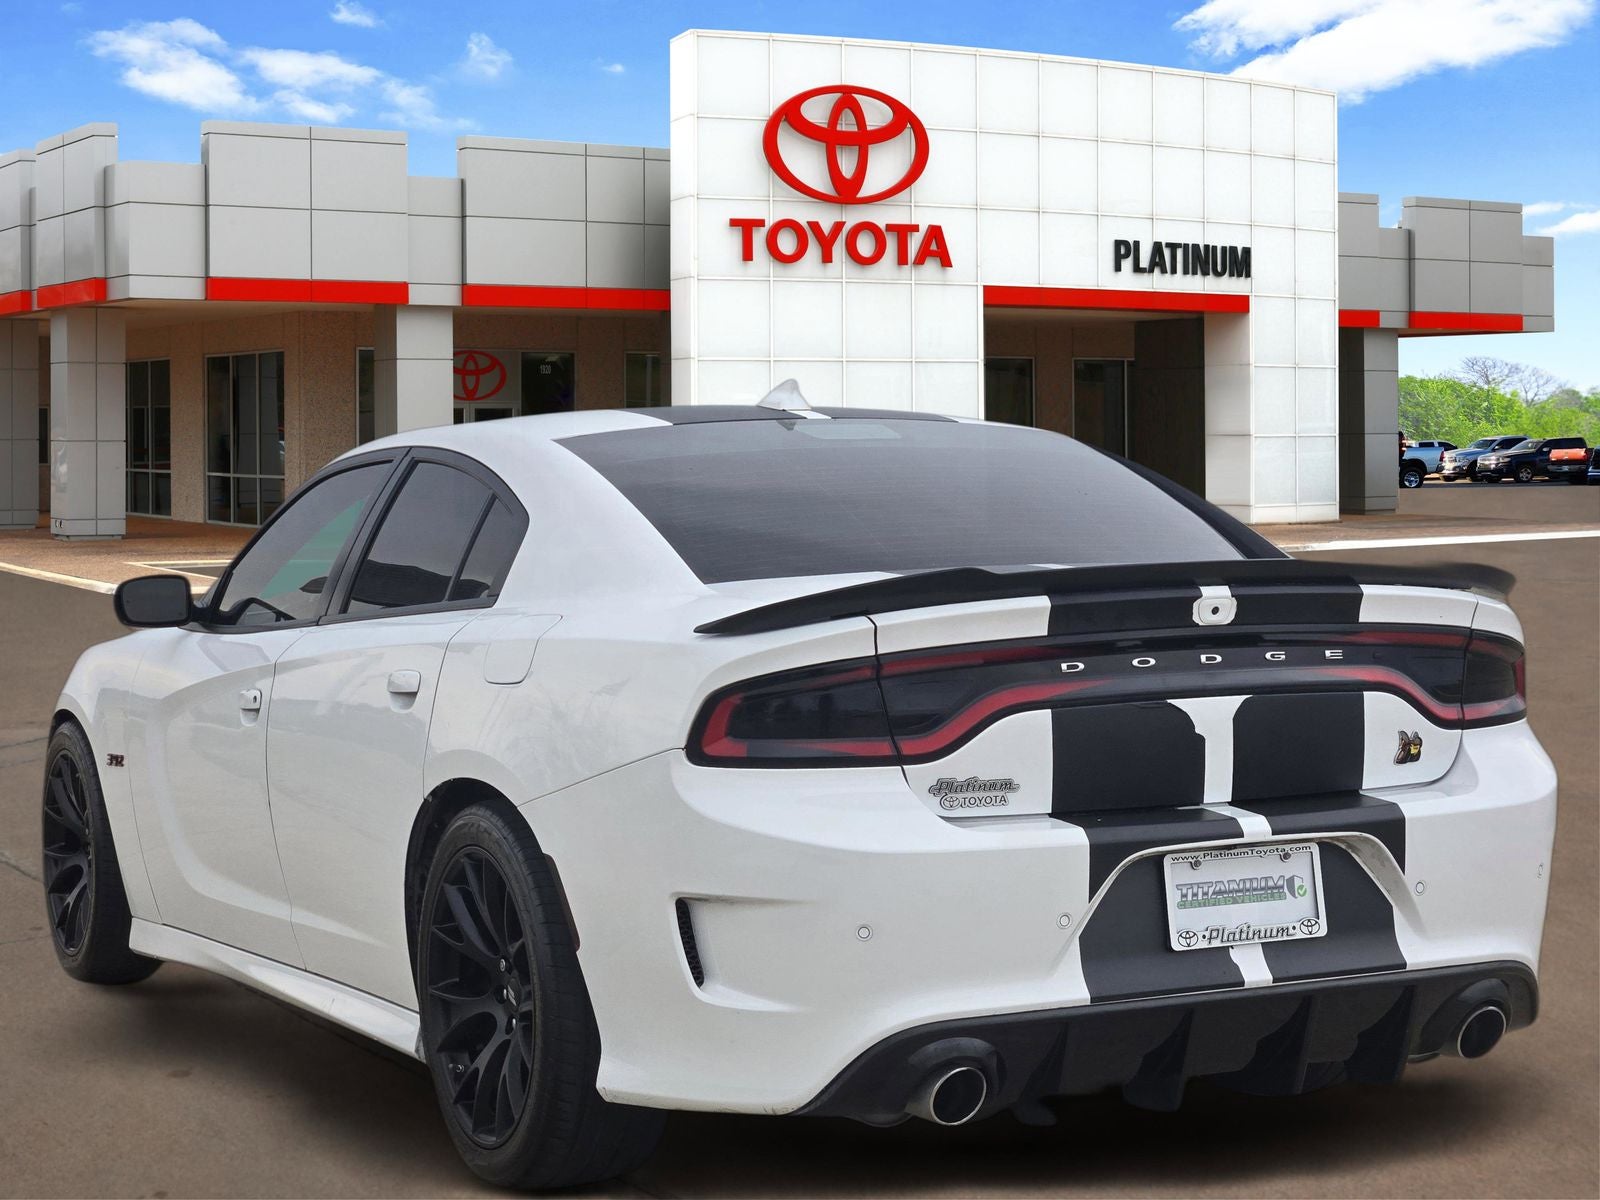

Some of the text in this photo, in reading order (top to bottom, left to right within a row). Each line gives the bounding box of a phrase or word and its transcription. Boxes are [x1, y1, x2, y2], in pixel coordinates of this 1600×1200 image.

[729, 218, 953, 268] TOYOTA
[1114, 239, 1252, 278] PLATINUM
[1060, 649, 1344, 673] DODGE
[930, 778, 1019, 796] Platinum
[961, 795, 1007, 807] TOYOTA
[1171, 845, 1311, 862] www.PlatinumToyota.com
[1176, 876, 1285, 900] TITANIUM
[1177, 892, 1286, 909] CERTIFIED VEHICLES
[1207, 925, 1295, 945] Platinum
